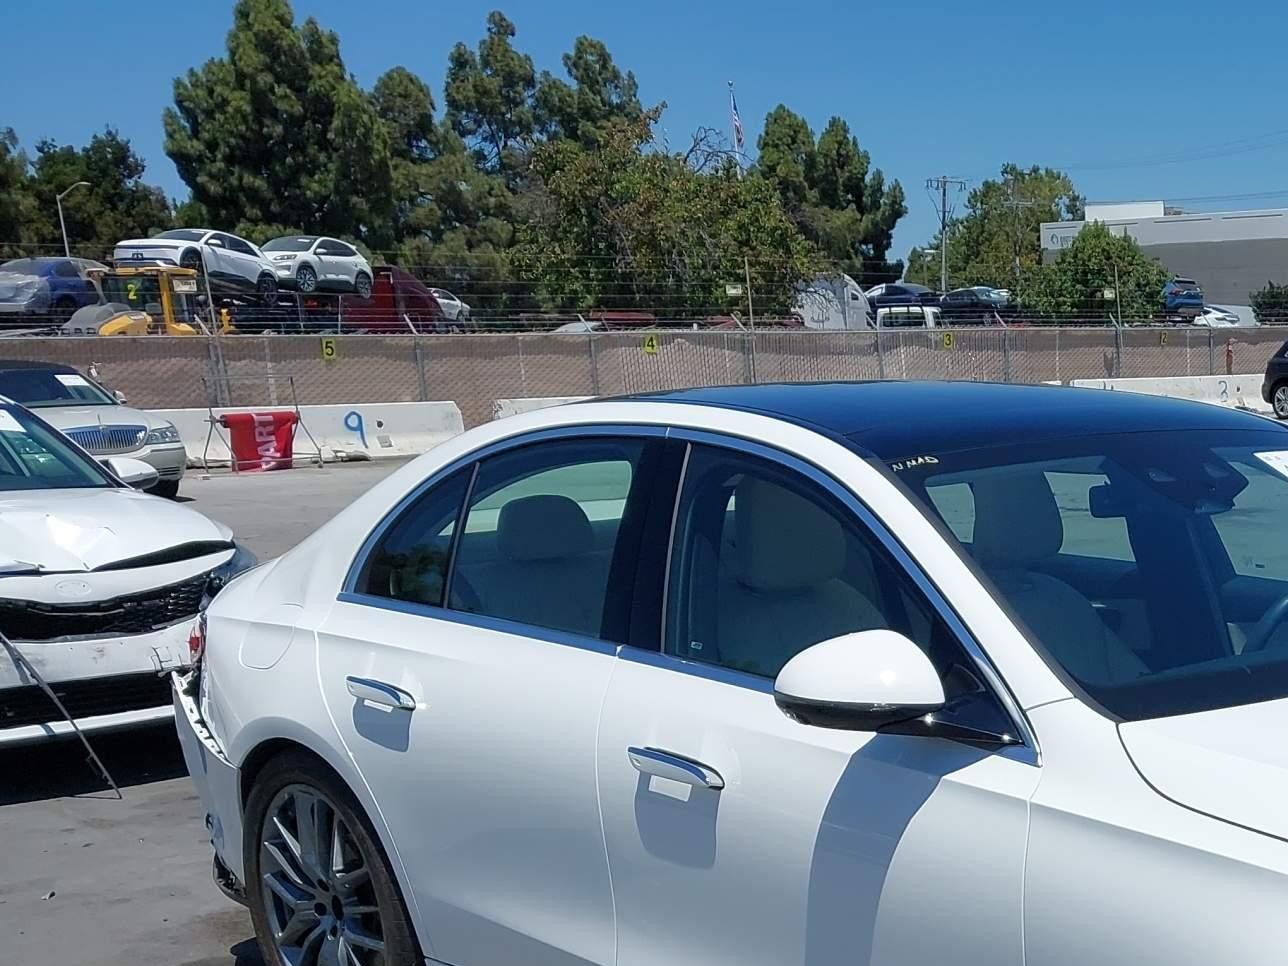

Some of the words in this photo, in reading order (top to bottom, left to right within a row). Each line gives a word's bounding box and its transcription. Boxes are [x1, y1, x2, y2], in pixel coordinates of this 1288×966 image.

[646, 335, 656, 350] 4
[945, 333, 952, 346] 3
[324, 340, 335, 356] 5
[344, 410, 369, 449] 9
